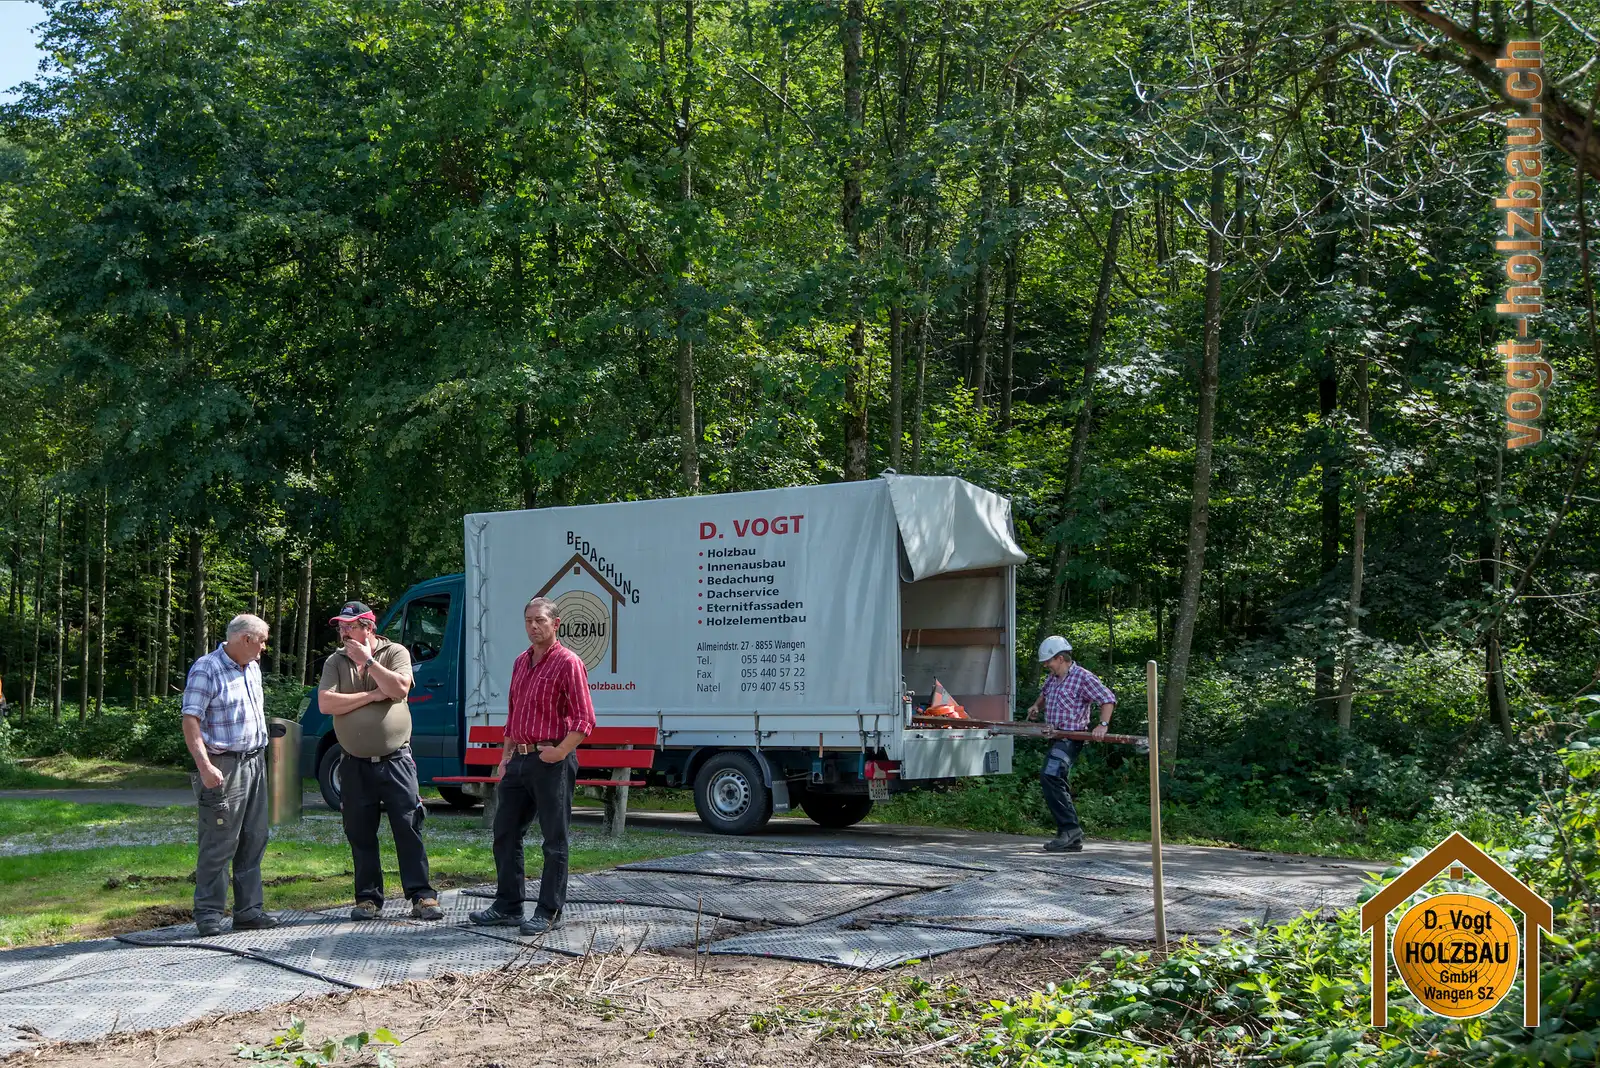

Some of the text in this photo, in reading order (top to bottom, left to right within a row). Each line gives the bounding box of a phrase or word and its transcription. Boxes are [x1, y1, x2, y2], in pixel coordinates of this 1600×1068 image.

[699, 515, 804, 540] D. VOGT
[707, 547, 756, 558] Holzbau
[567, 531, 640, 604] BEDACHUNG
[707, 559, 786, 572] Innenausbau
[707, 574, 774, 585] Bedachung
[707, 587, 780, 599] Dachservice
[706, 600, 804, 613] Eternitfassaden
[706, 614, 807, 626] Holzelementbau
[556, 622, 606, 637] OLZBAU
[696, 642, 739, 651] Allmeindstr.
[740, 641, 750, 650] 27
[755, 641, 773, 650] 8855
[774, 640, 805, 651] Wangen
[697, 653, 805, 665] Tel. 055 440 54 34
[697, 667, 805, 679] Fax 055 440 57 22
[696, 682, 805, 692] Natel 079 407 45 53
